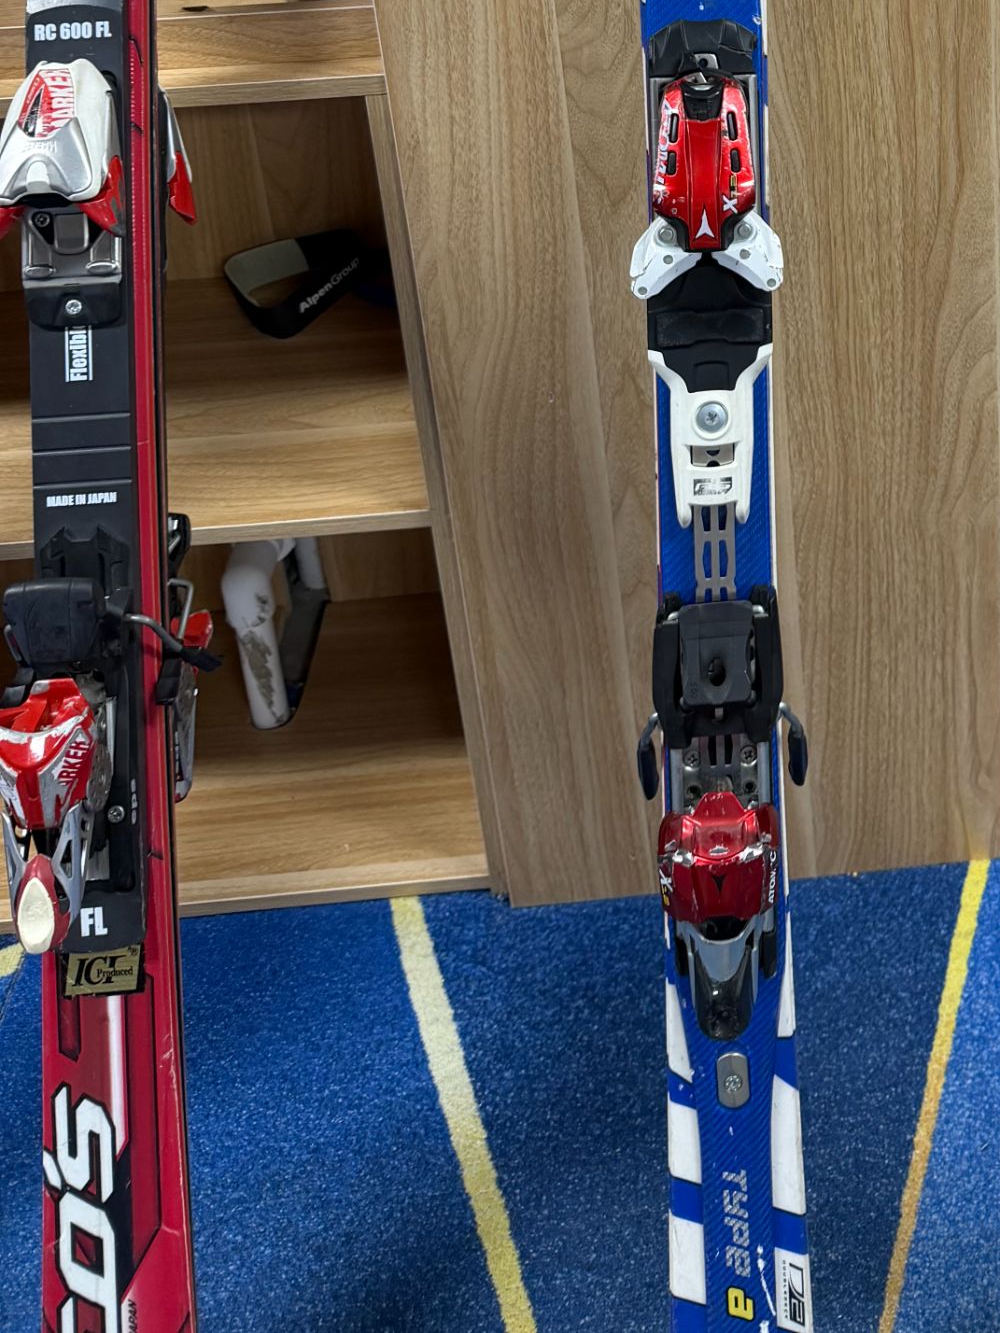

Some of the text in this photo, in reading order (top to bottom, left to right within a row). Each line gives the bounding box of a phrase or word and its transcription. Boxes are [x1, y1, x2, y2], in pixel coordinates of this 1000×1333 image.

[34, 21, 112, 41] RC 600 FL
[300, 256, 360, 315] AlpenGroup
[69, 326, 88, 381] Flexibl
[46, 491, 117, 507] MADE IN JAPAN
[58, 742, 90, 786] RKER
[81, 907, 108, 936] FL
[97, 968, 133, 980] Produced
